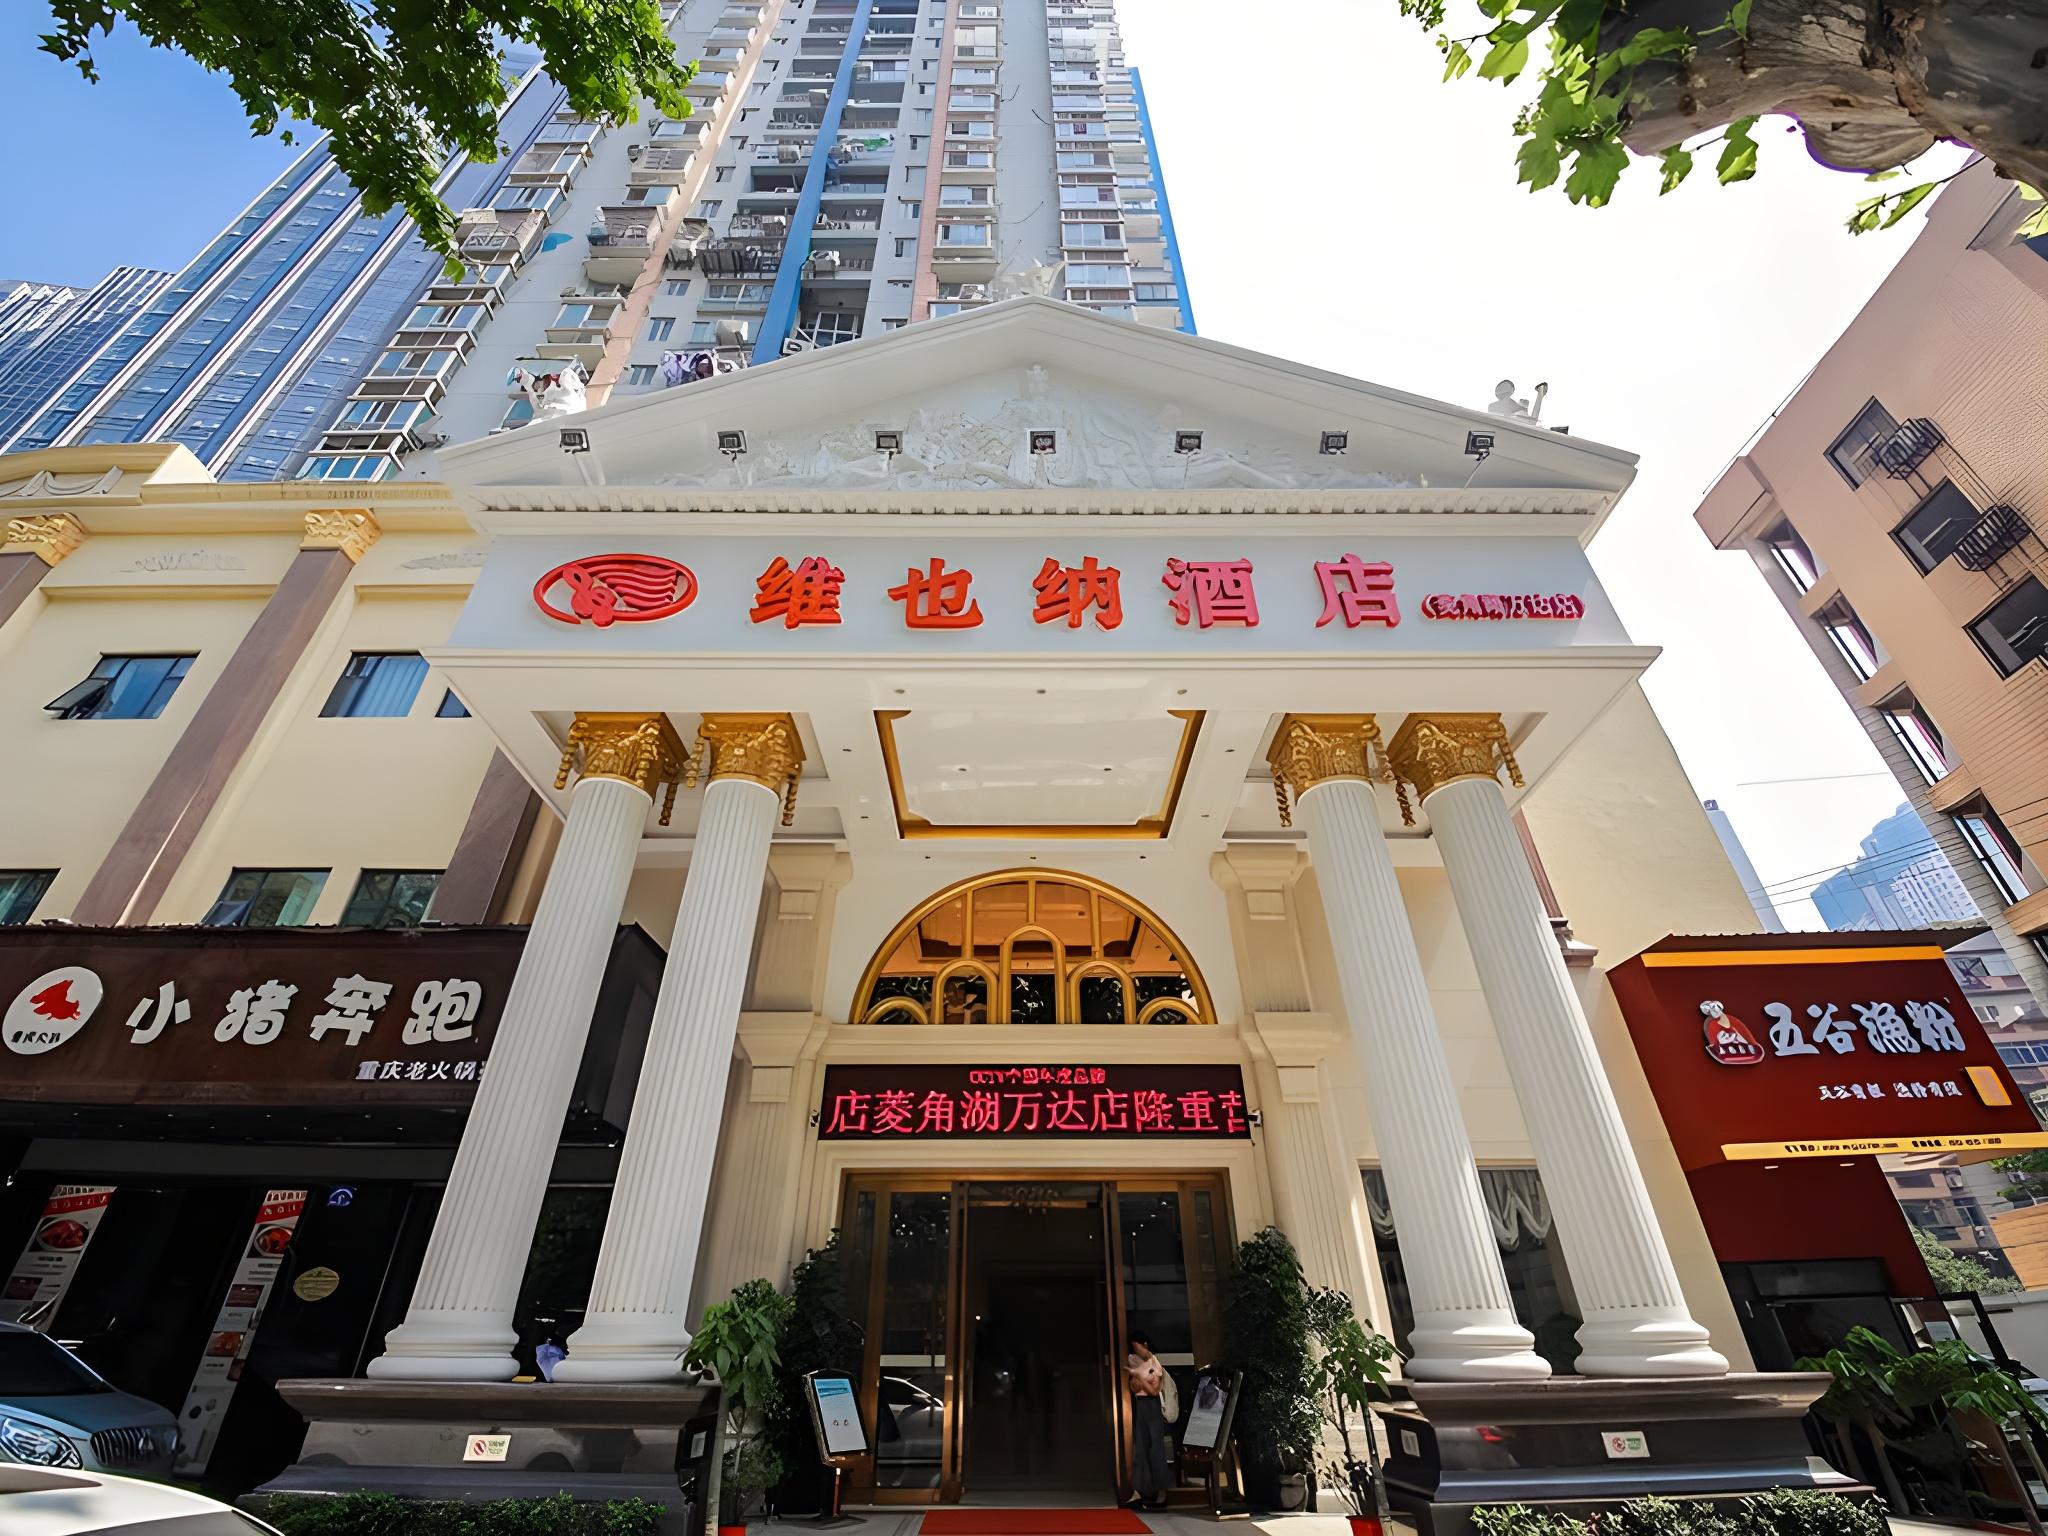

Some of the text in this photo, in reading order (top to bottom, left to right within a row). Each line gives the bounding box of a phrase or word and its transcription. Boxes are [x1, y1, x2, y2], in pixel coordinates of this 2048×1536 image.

[748, 552, 1401, 631] 维也纳酒店
[126, 973, 482, 1047] 小猪奔跑
